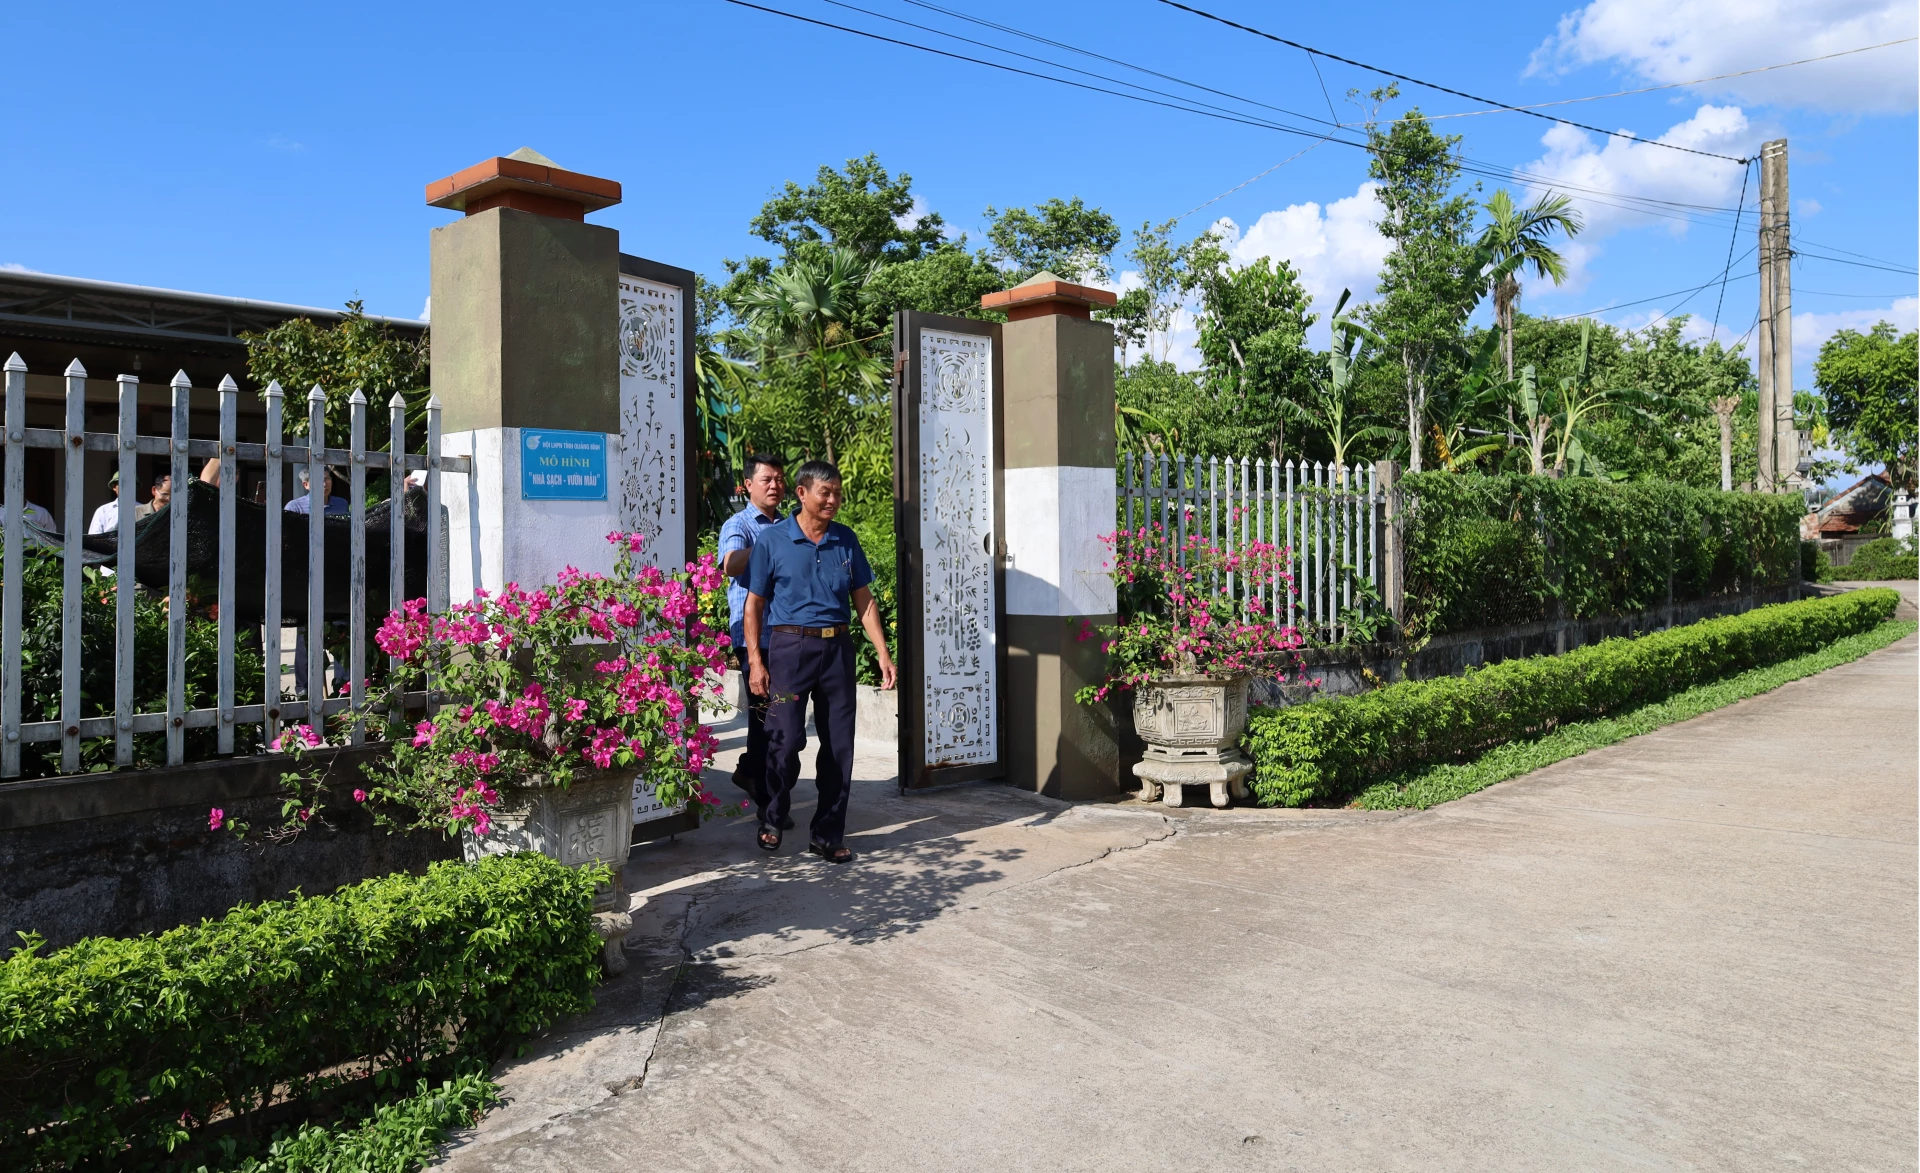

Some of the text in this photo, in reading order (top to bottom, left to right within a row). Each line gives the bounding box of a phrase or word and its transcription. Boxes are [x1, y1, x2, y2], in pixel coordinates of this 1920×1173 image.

[539, 454, 590, 468] MÔ HÌNH
[546, 473, 562, 488] SẠCH
[567, 472, 583, 486] VƯỜN
